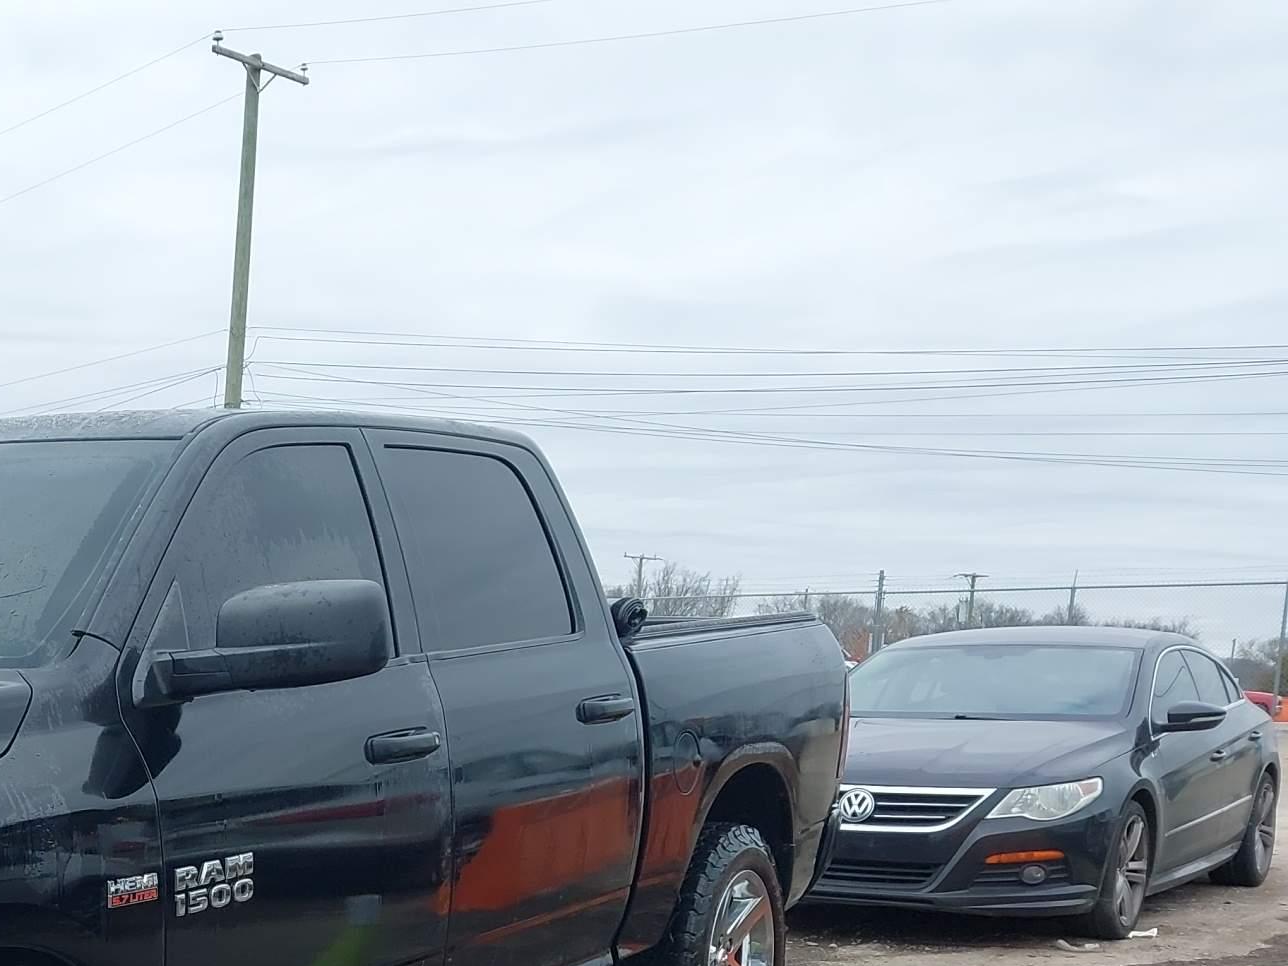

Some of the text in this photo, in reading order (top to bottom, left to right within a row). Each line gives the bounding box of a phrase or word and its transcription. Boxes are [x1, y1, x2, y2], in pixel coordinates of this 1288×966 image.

[840, 788, 875, 823] VW
[107, 872, 159, 895] HEMI
[174, 851, 254, 891] RAM
[175, 878, 254, 917] 1500
